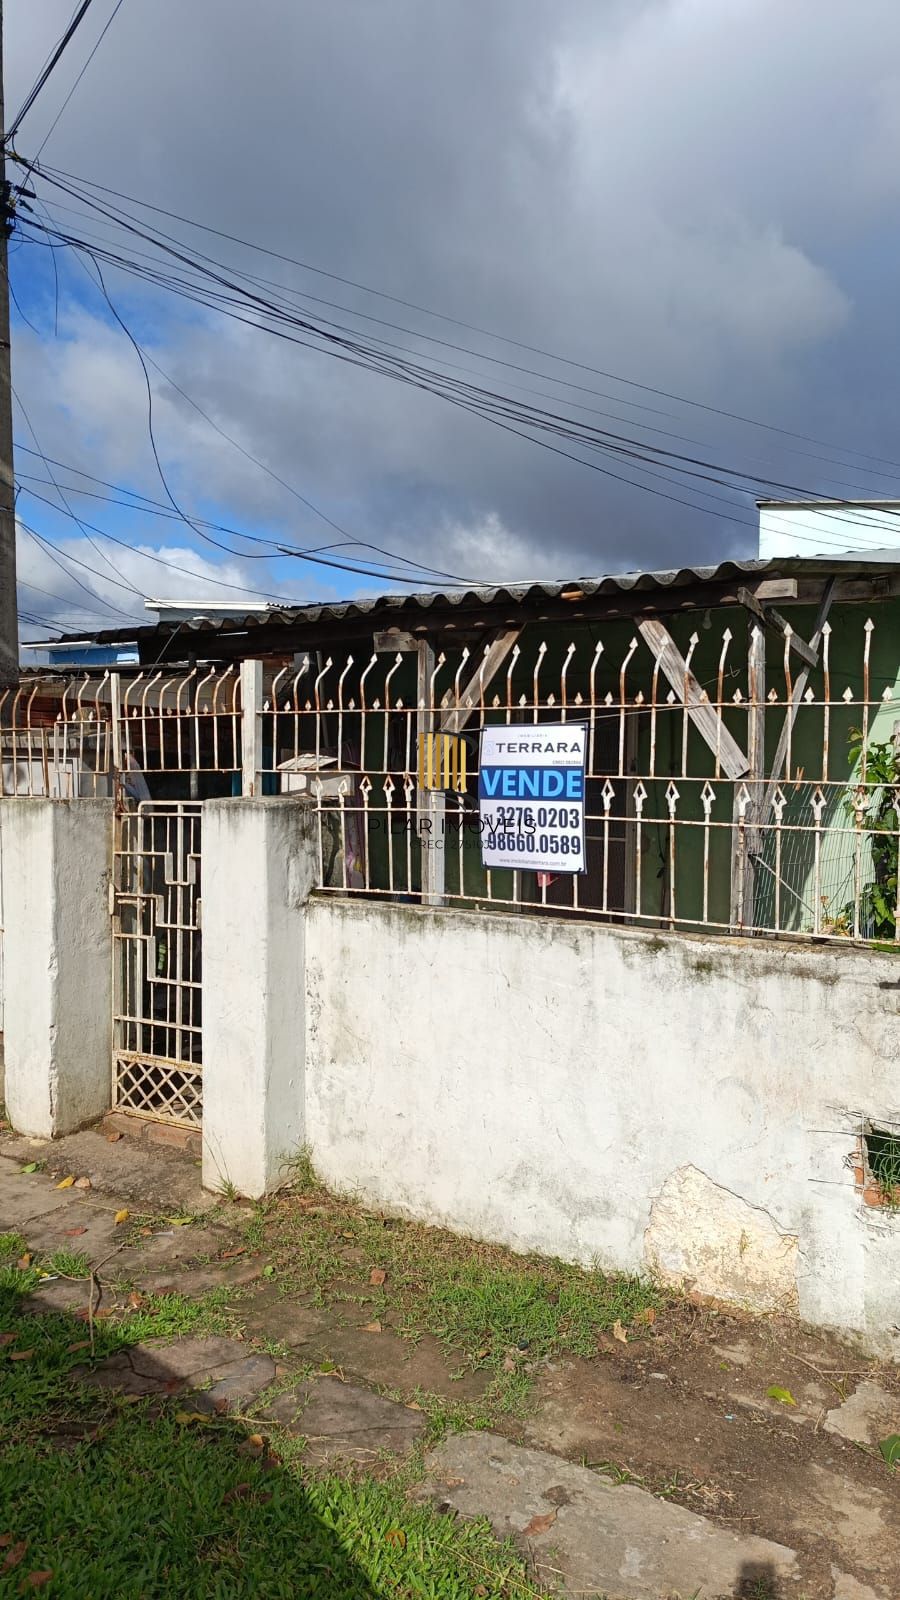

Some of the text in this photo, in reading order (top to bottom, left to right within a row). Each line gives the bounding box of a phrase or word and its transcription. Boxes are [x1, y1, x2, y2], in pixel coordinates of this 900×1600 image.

[496, 742, 582, 754] TERRARA
[481, 769, 582, 798] VENDE
[496, 806, 580, 829] 3276.0203
[488, 831, 581, 855] 98660.0589
